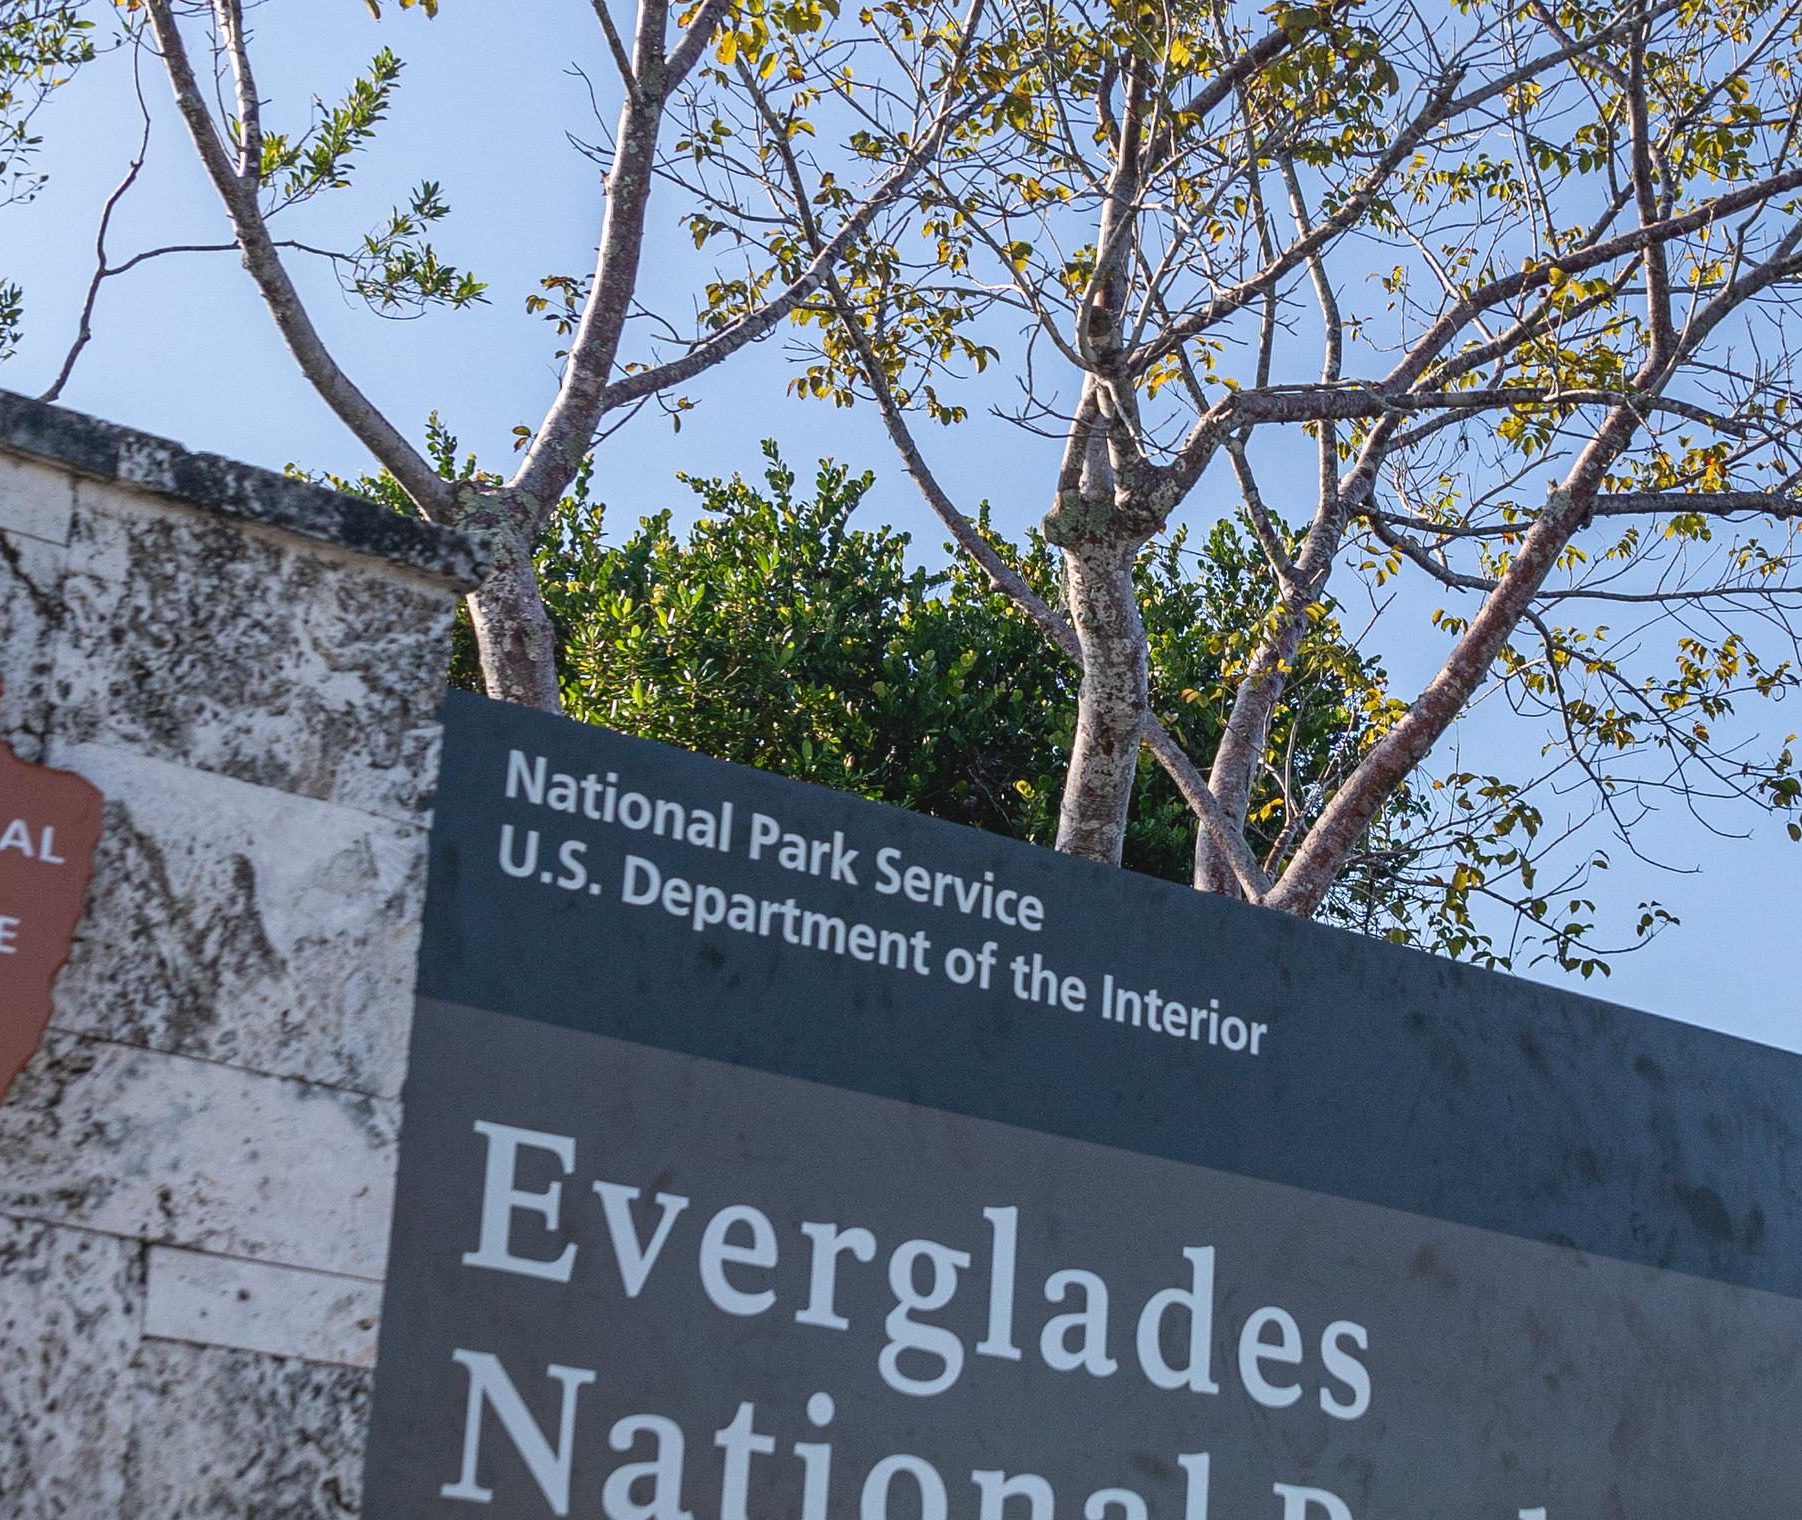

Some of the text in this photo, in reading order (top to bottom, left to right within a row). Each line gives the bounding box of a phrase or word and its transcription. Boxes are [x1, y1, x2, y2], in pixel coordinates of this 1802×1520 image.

[498, 824, 1269, 1056] U.S. Department of the Interior
[506, 749, 1046, 932] National Park Service
[461, 1119, 1373, 1421] Everglades
